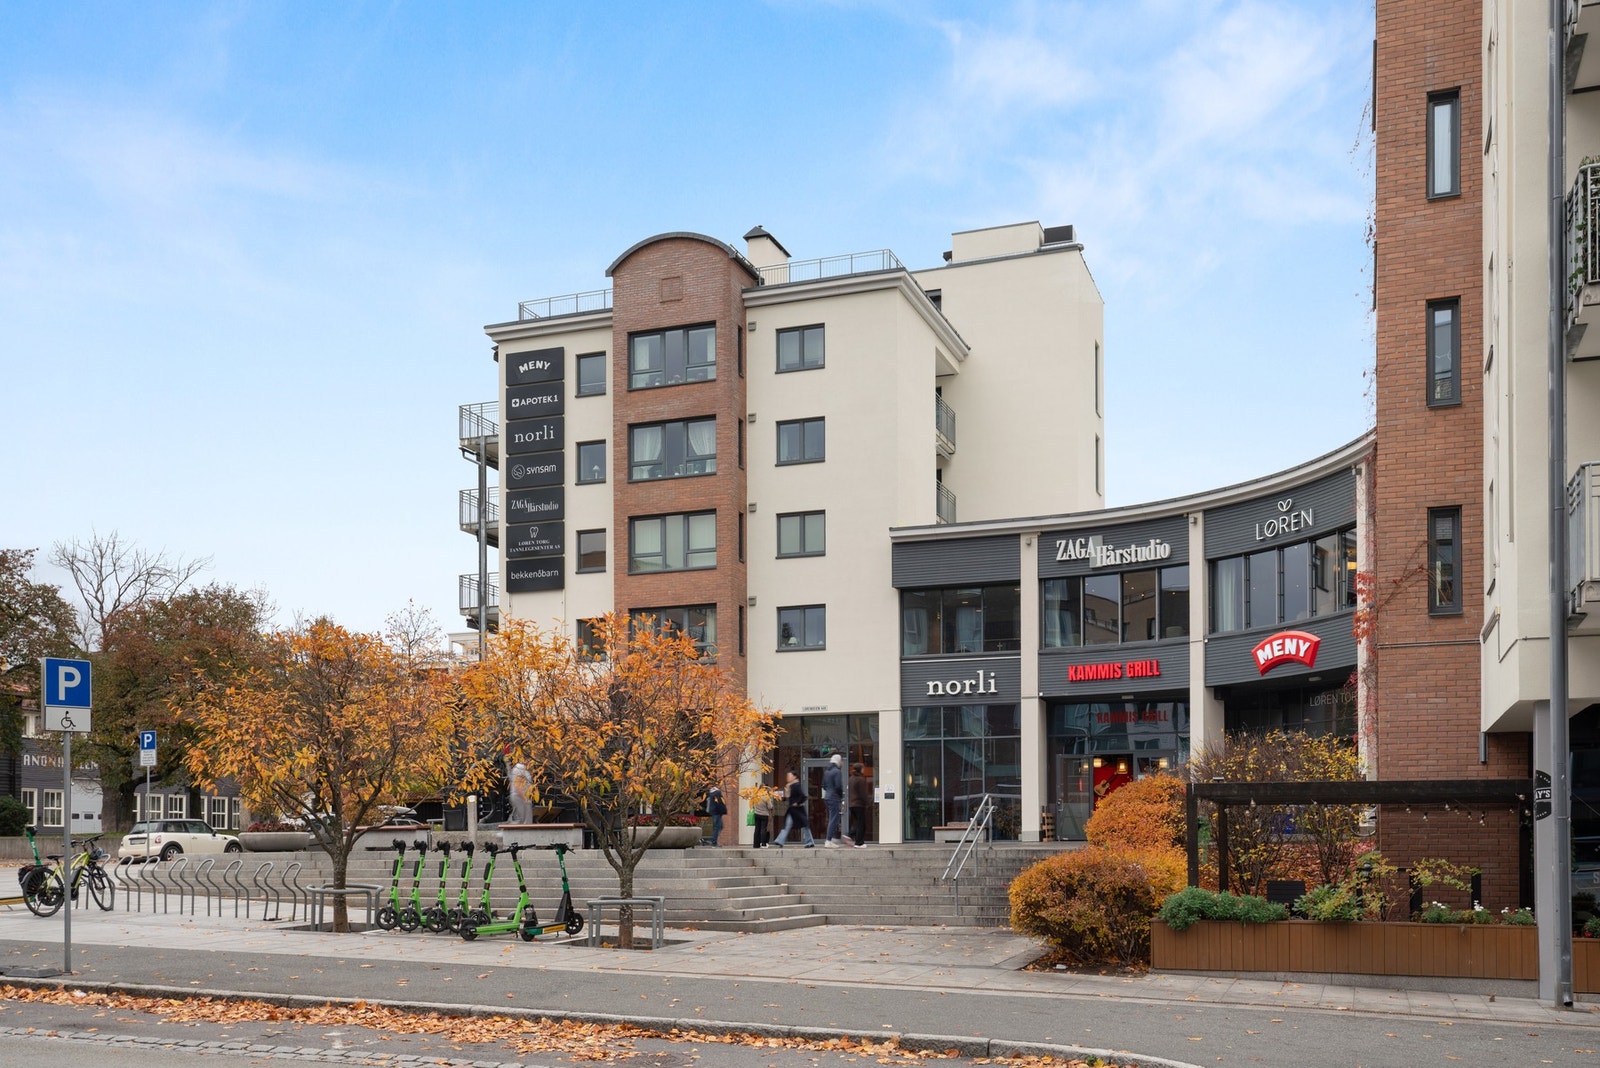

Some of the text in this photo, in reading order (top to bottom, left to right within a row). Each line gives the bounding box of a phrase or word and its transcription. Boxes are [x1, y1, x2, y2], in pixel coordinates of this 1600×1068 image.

[518, 360, 551, 374] MENY
[520, 395, 559, 406] APOTEK 1
[514, 425, 555, 443] norli
[511, 499, 528, 510] ZAGA
[1255, 508, 1314, 541] LØREN
[1056, 537, 1171, 567] ZAGA Hårstudio
[1256, 637, 1311, 665] MENY
[1067, 659, 1161, 682] KAMMIS GRILL
[58, 665, 82, 701] P
[926, 669, 998, 696] norli
[1340, 691, 1358, 703] TOR
[144, 733, 153, 748] P
